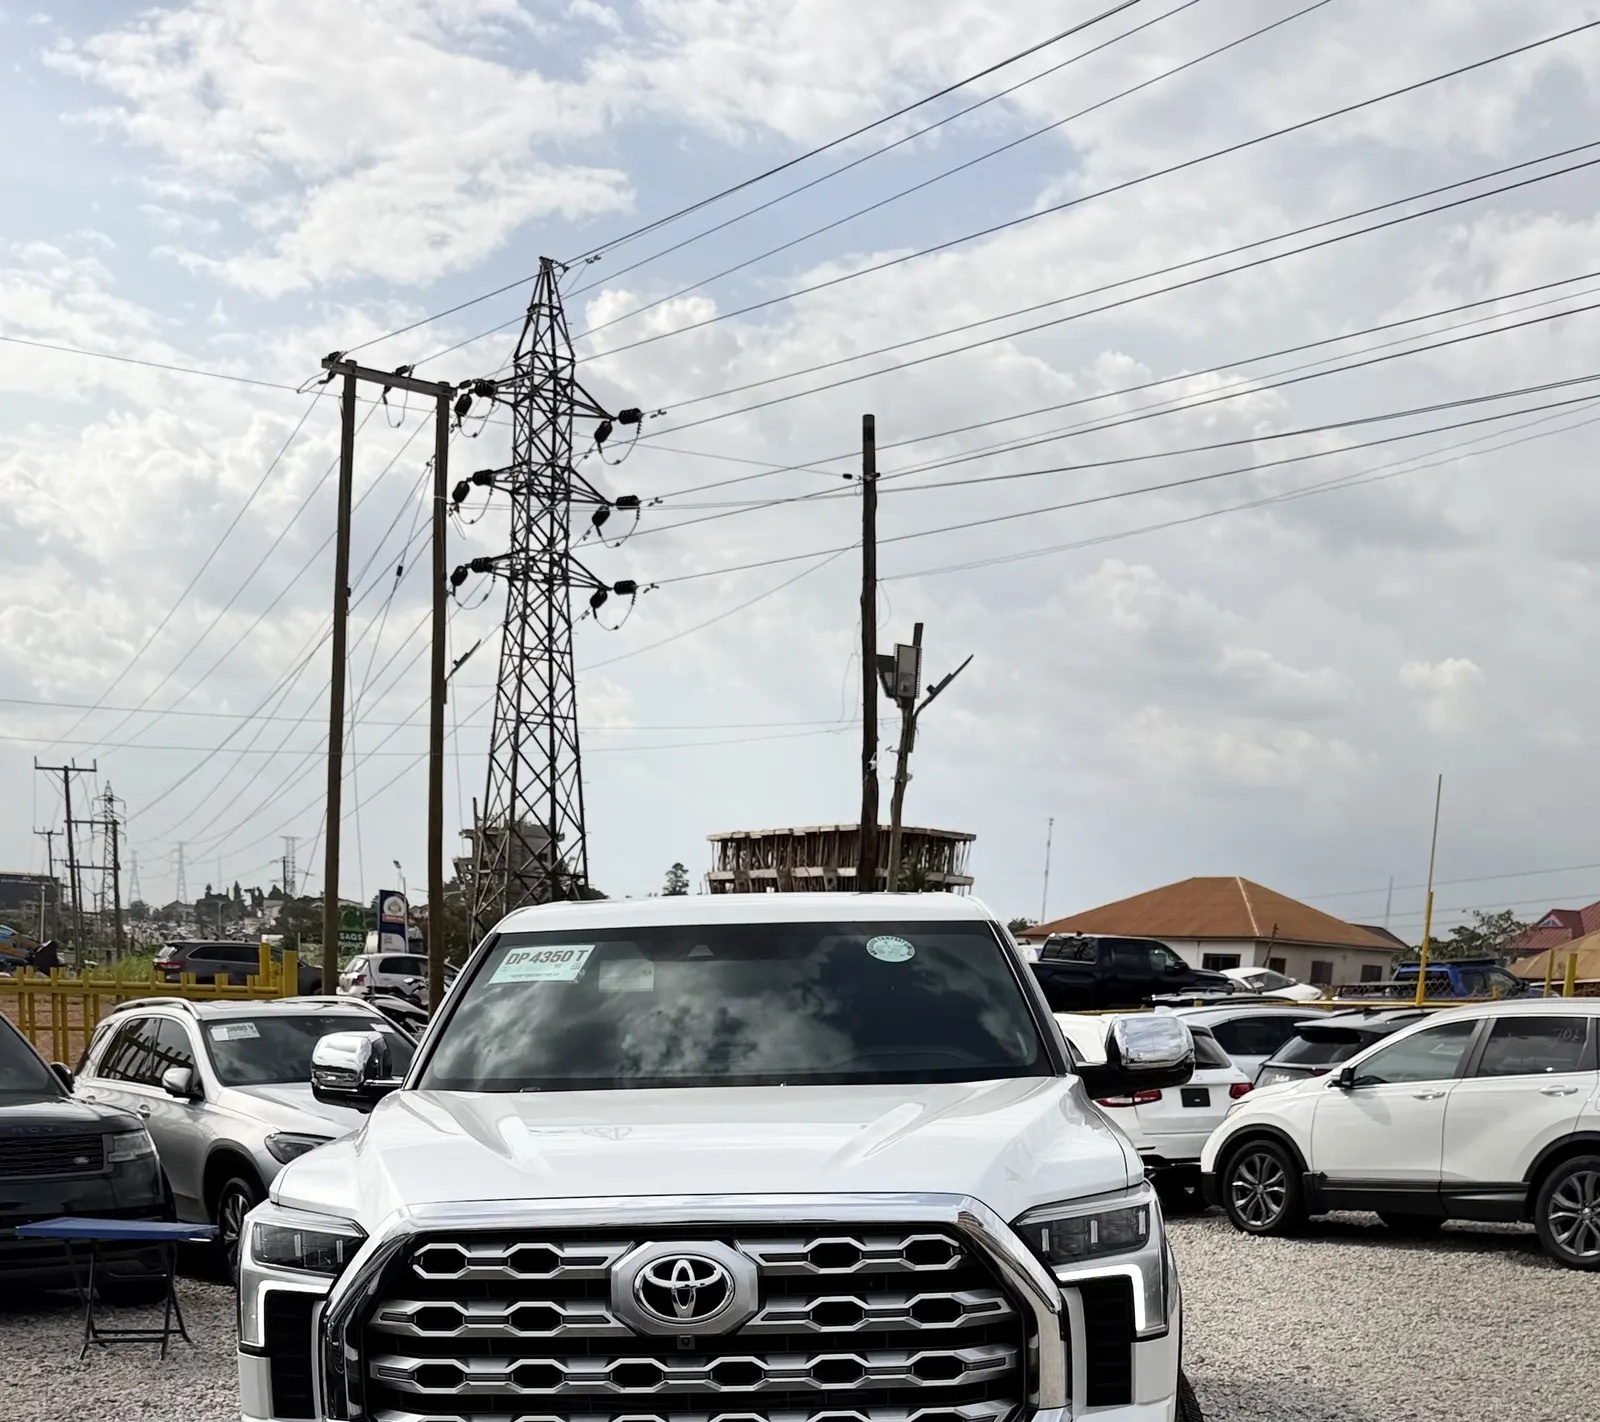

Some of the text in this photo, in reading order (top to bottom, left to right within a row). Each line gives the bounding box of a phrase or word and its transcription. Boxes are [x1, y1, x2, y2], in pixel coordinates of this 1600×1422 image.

[505, 950, 590, 965] DP 4350 T
